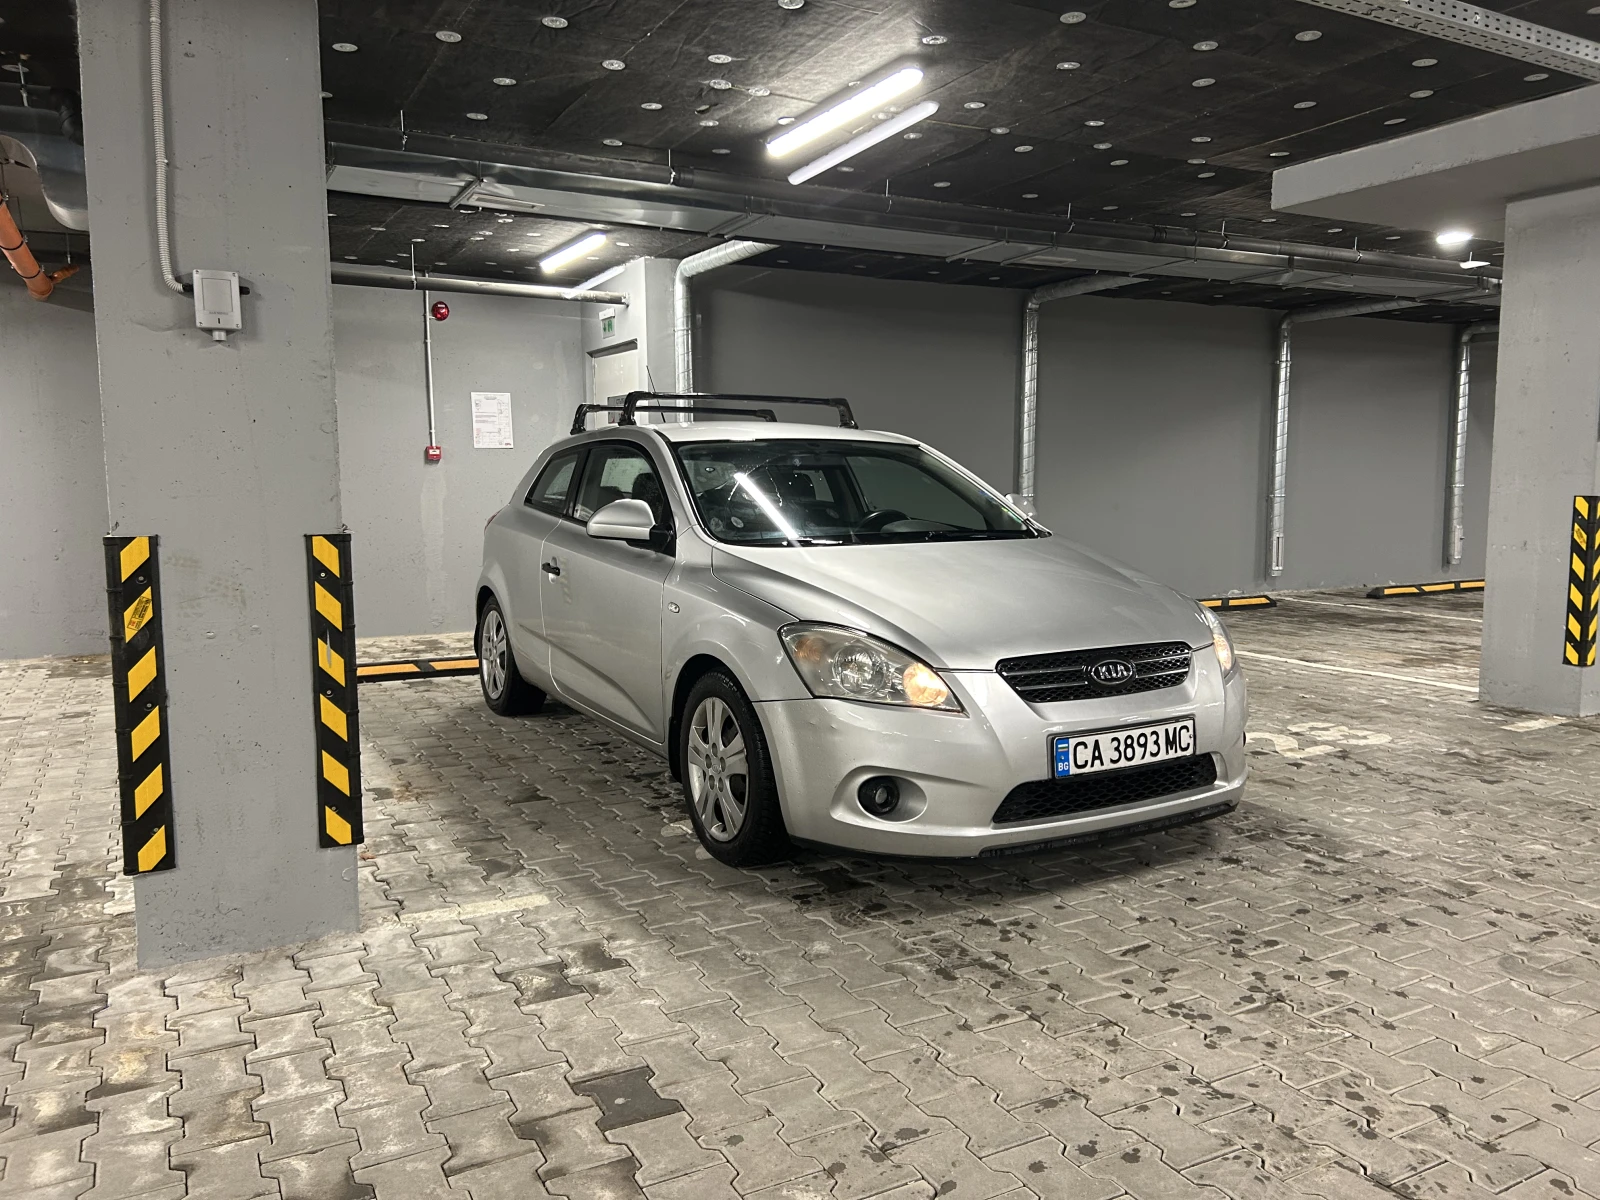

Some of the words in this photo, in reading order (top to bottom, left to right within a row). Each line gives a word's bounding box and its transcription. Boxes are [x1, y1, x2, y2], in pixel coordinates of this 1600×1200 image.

[1098, 664, 1128, 679] KIA
[1073, 739, 1104, 769] CA
[1109, 730, 1161, 764] 3893
[1165, 725, 1191, 755] MC
[1057, 761, 1069, 772] BG
